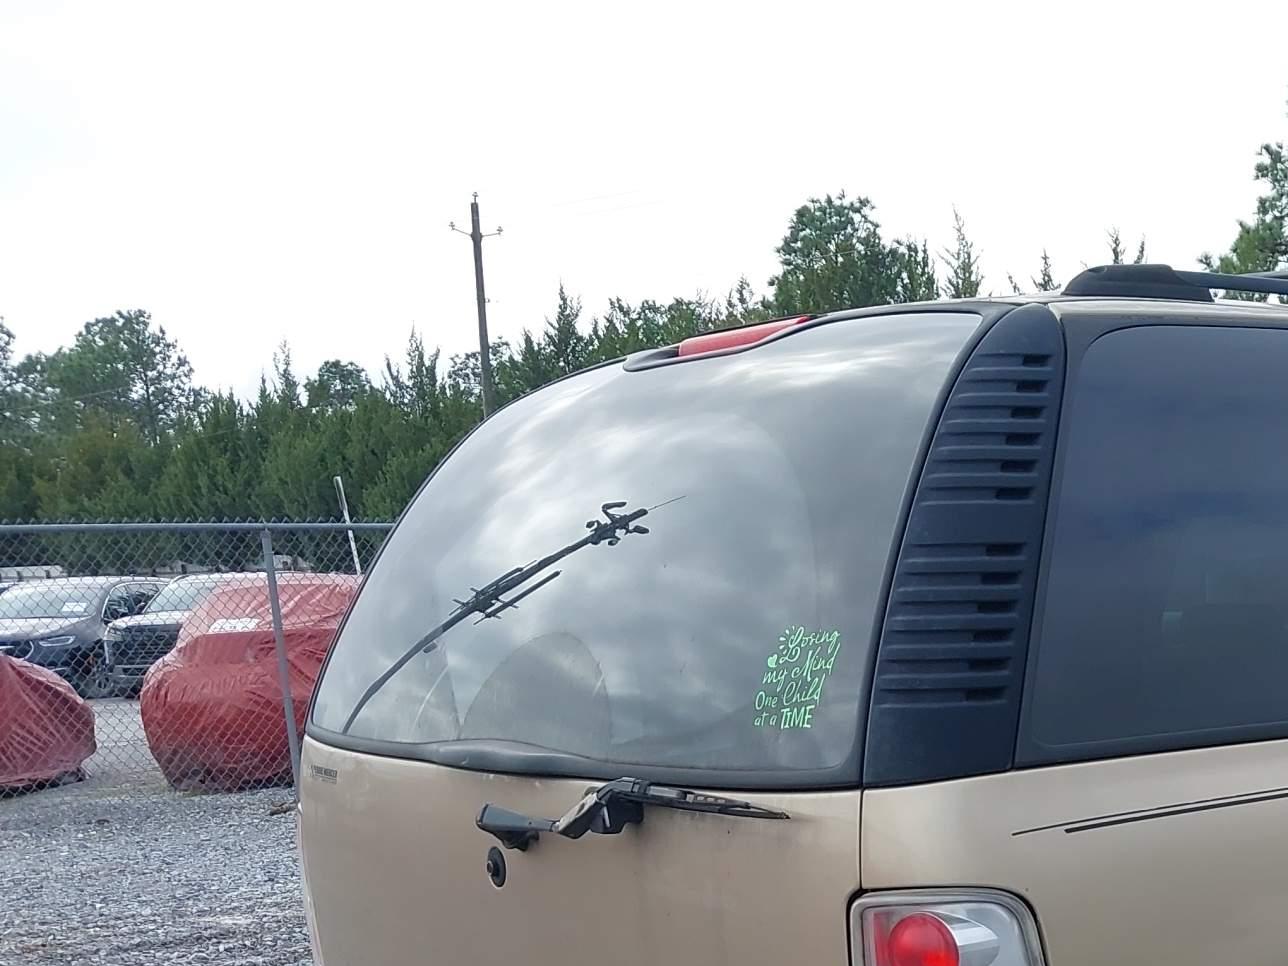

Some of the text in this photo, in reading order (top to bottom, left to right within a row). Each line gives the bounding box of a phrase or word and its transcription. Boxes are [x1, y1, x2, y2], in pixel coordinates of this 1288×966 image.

[779, 626, 841, 663] Losing
[762, 643, 841, 692] my Mind
[755, 673, 825, 710] One Child
[754, 705, 815, 730] at a TIME
